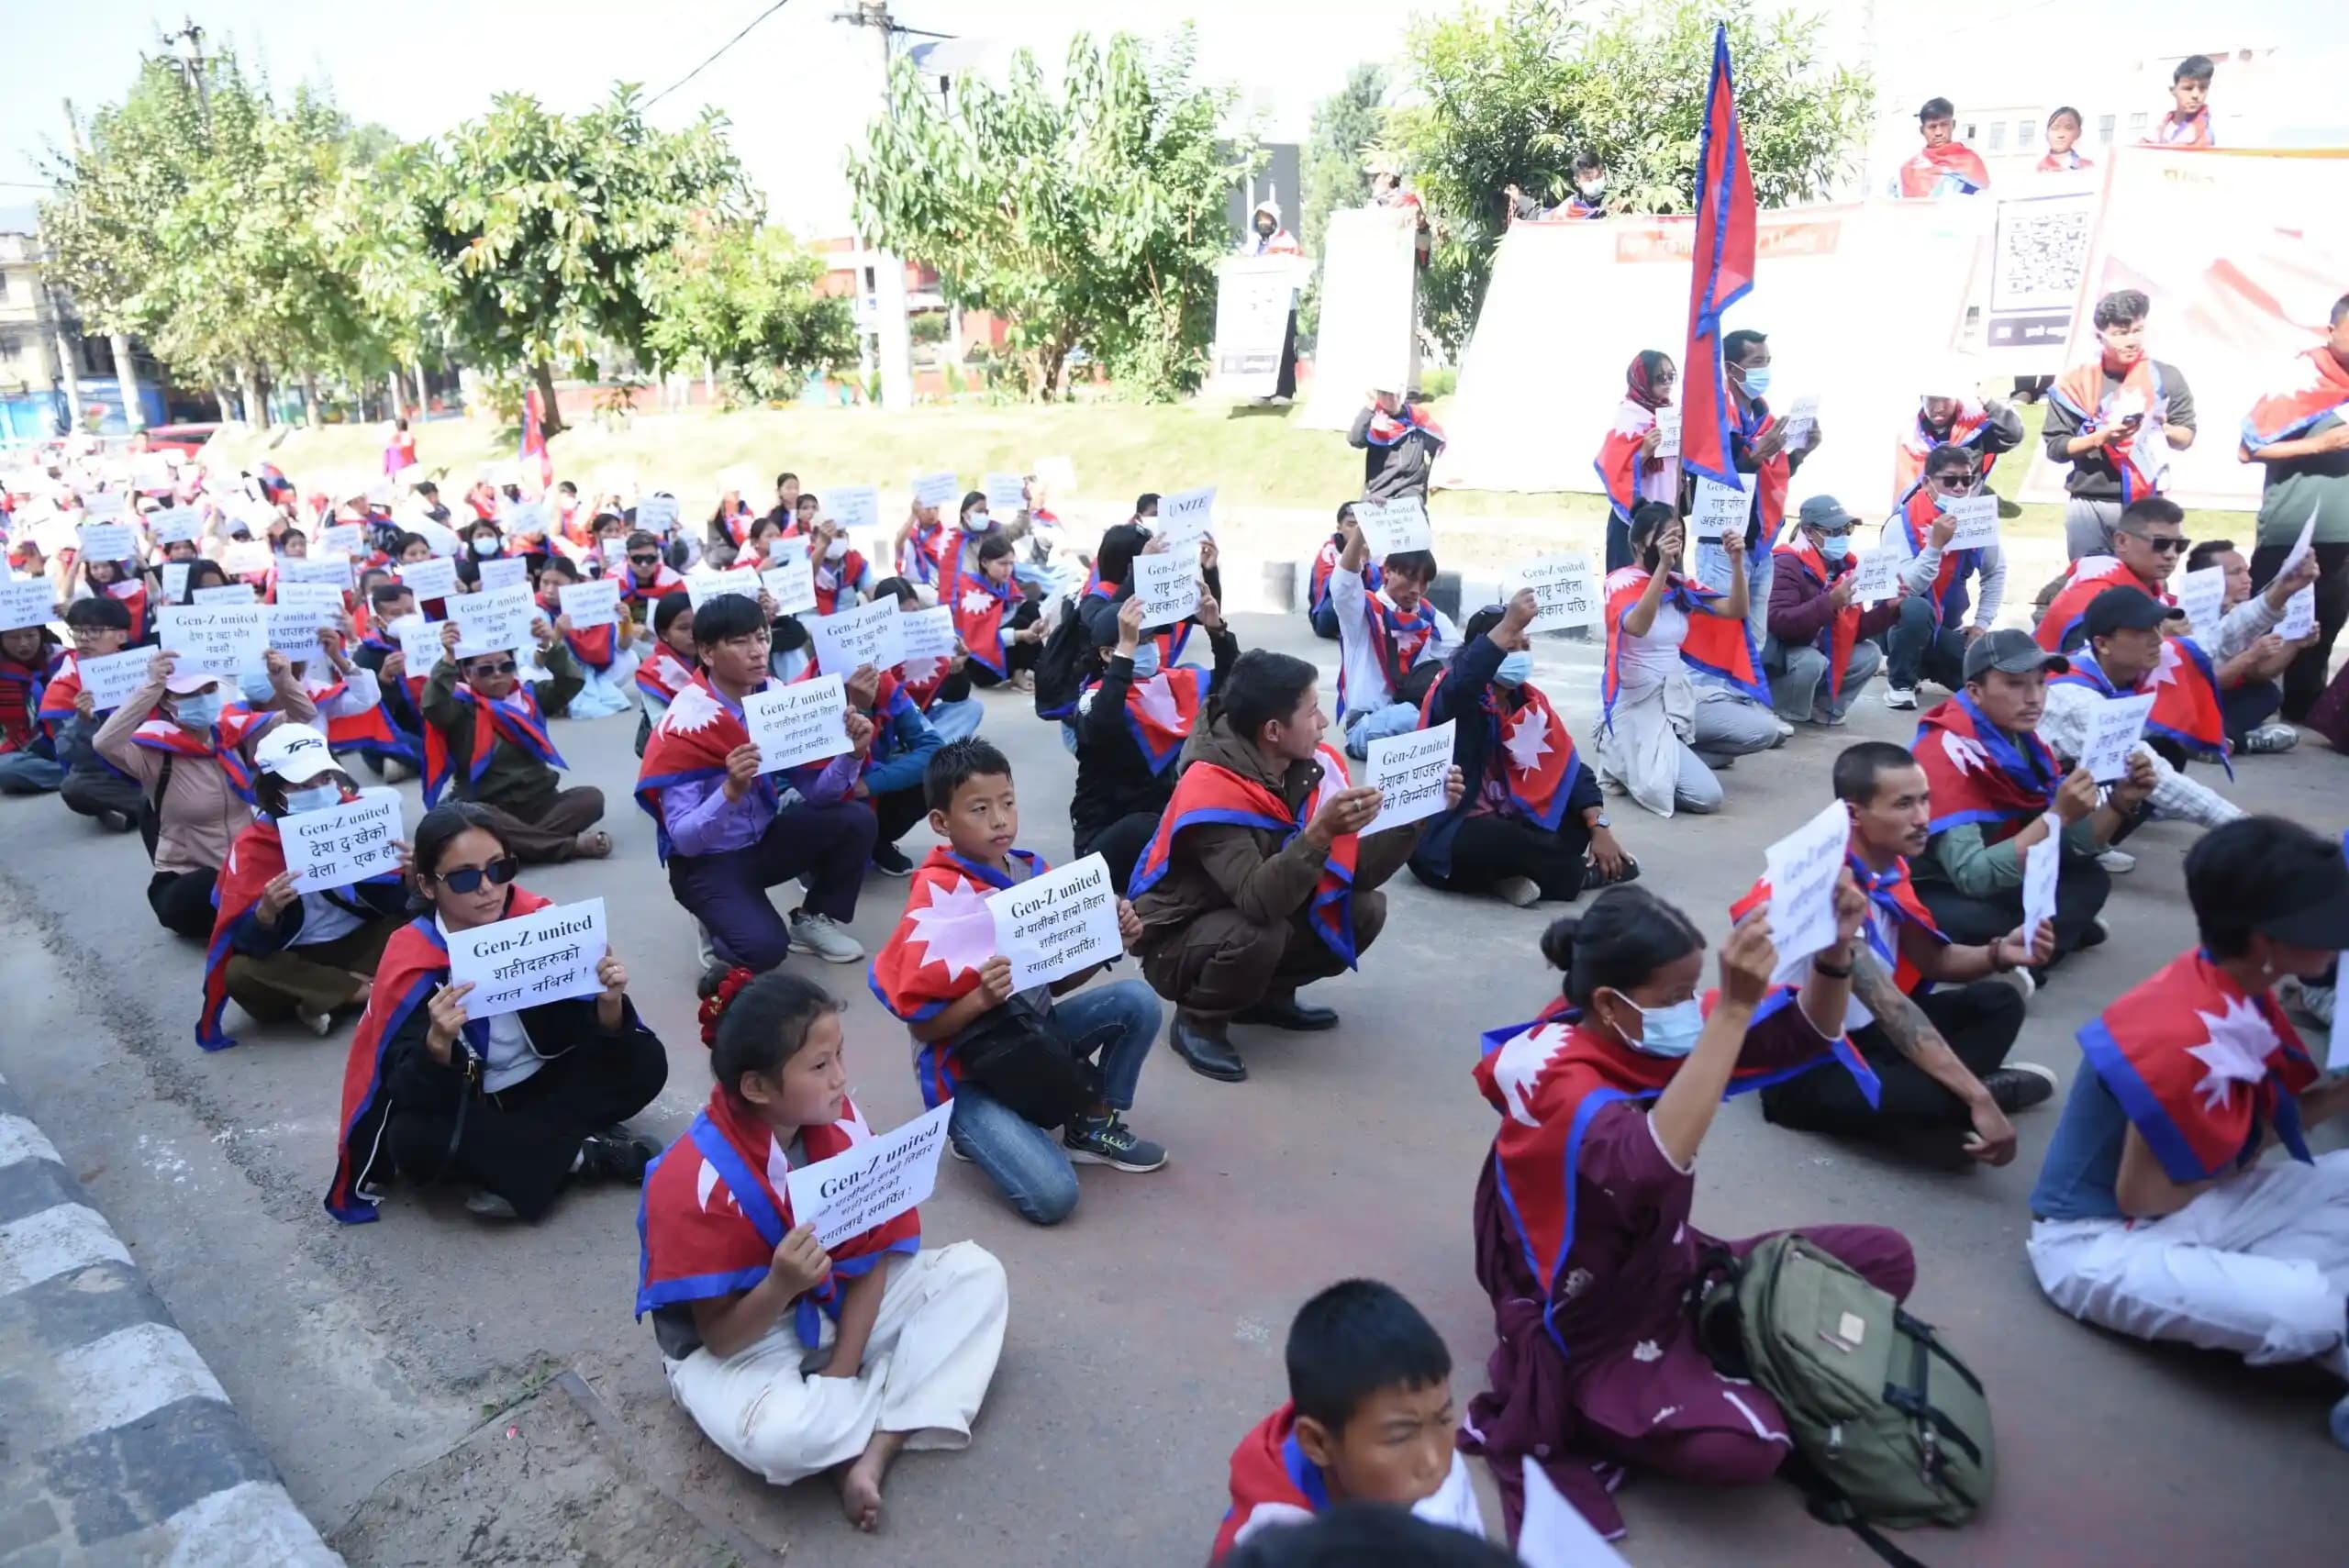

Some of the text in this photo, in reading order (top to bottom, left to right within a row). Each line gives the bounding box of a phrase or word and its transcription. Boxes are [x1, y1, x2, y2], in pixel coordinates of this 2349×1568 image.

[1148, 561, 1177, 576] Gen-Z
[1522, 560, 1586, 579] Gen-Z united
[1554, 578, 1582, 595] पहिला
[176, 614, 217, 627] Gen-Z
[220, 612, 258, 625] united
[827, 606, 892, 636] Gen-Z united
[1537, 603, 1564, 619] हंकार
[1567, 597, 1586, 614] पछि
[760, 686, 837, 717] Gen-Z united
[1383, 734, 1451, 766] Gen-Z united
[1378, 771, 1409, 792] देशका
[1398, 778, 1442, 806] जिम्मेवारी
[299, 804, 390, 838] Gen-Z united
[309, 840, 335, 857] देश
[308, 862, 337, 879] बेला
[352, 850, 377, 868] एक
[1011, 869, 1102, 918] Gen-Z united
[1014, 893, 1106, 939] यो पालीको हाम्रो तिहार
[473, 915, 593, 959] Gen-Z united
[1026, 948, 1064, 973] रगतलाई
[486, 986, 524, 1004] रगत
[819, 1121, 939, 1198] Gen-Z united
